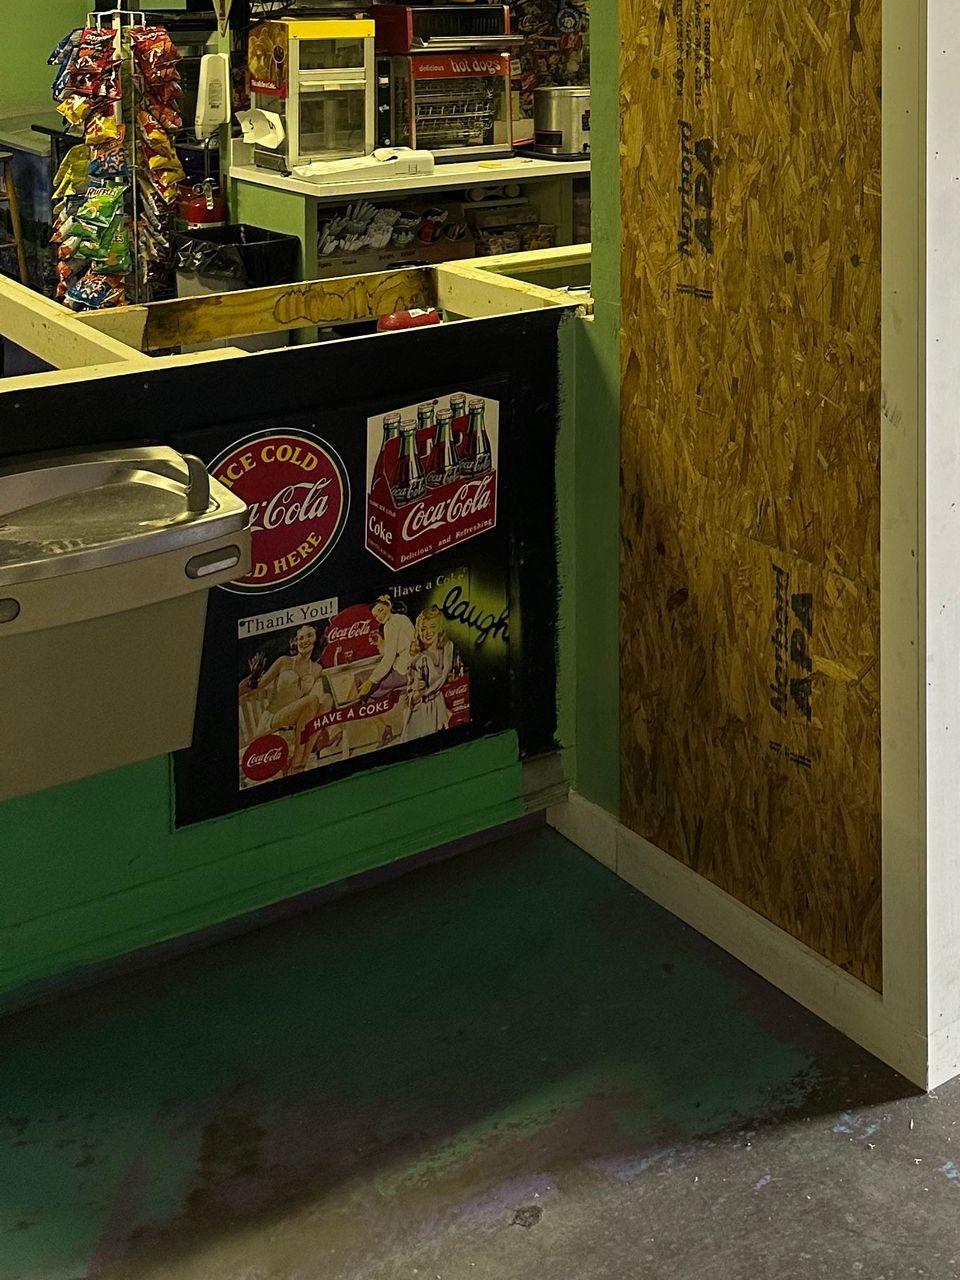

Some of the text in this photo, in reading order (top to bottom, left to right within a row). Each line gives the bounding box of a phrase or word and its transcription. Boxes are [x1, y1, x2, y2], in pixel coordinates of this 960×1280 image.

[419, 57, 501, 75] delicious hot dogs
[676, 119, 694, 257] Norbord
[694, 137, 714, 256] APA
[218, 444, 319, 488] ICE COLD
[402, 475, 494, 542] Coca-Cola
[369, 516, 393, 545] Coke
[400, 544, 433, 563] Delicious
[438, 534, 452, 546] and
[455, 518, 493, 540] Refreshing
[273, 531, 323, 575] HERE
[425, 582, 432, 590] a
[243, 601, 333, 634] Thank You!
[327, 619, 371, 644] Coca-Cola
[791, 592, 813, 722] APA
[314, 700, 390, 731] HAVE A COKE
[247, 747, 283, 768] Coca-Cola
